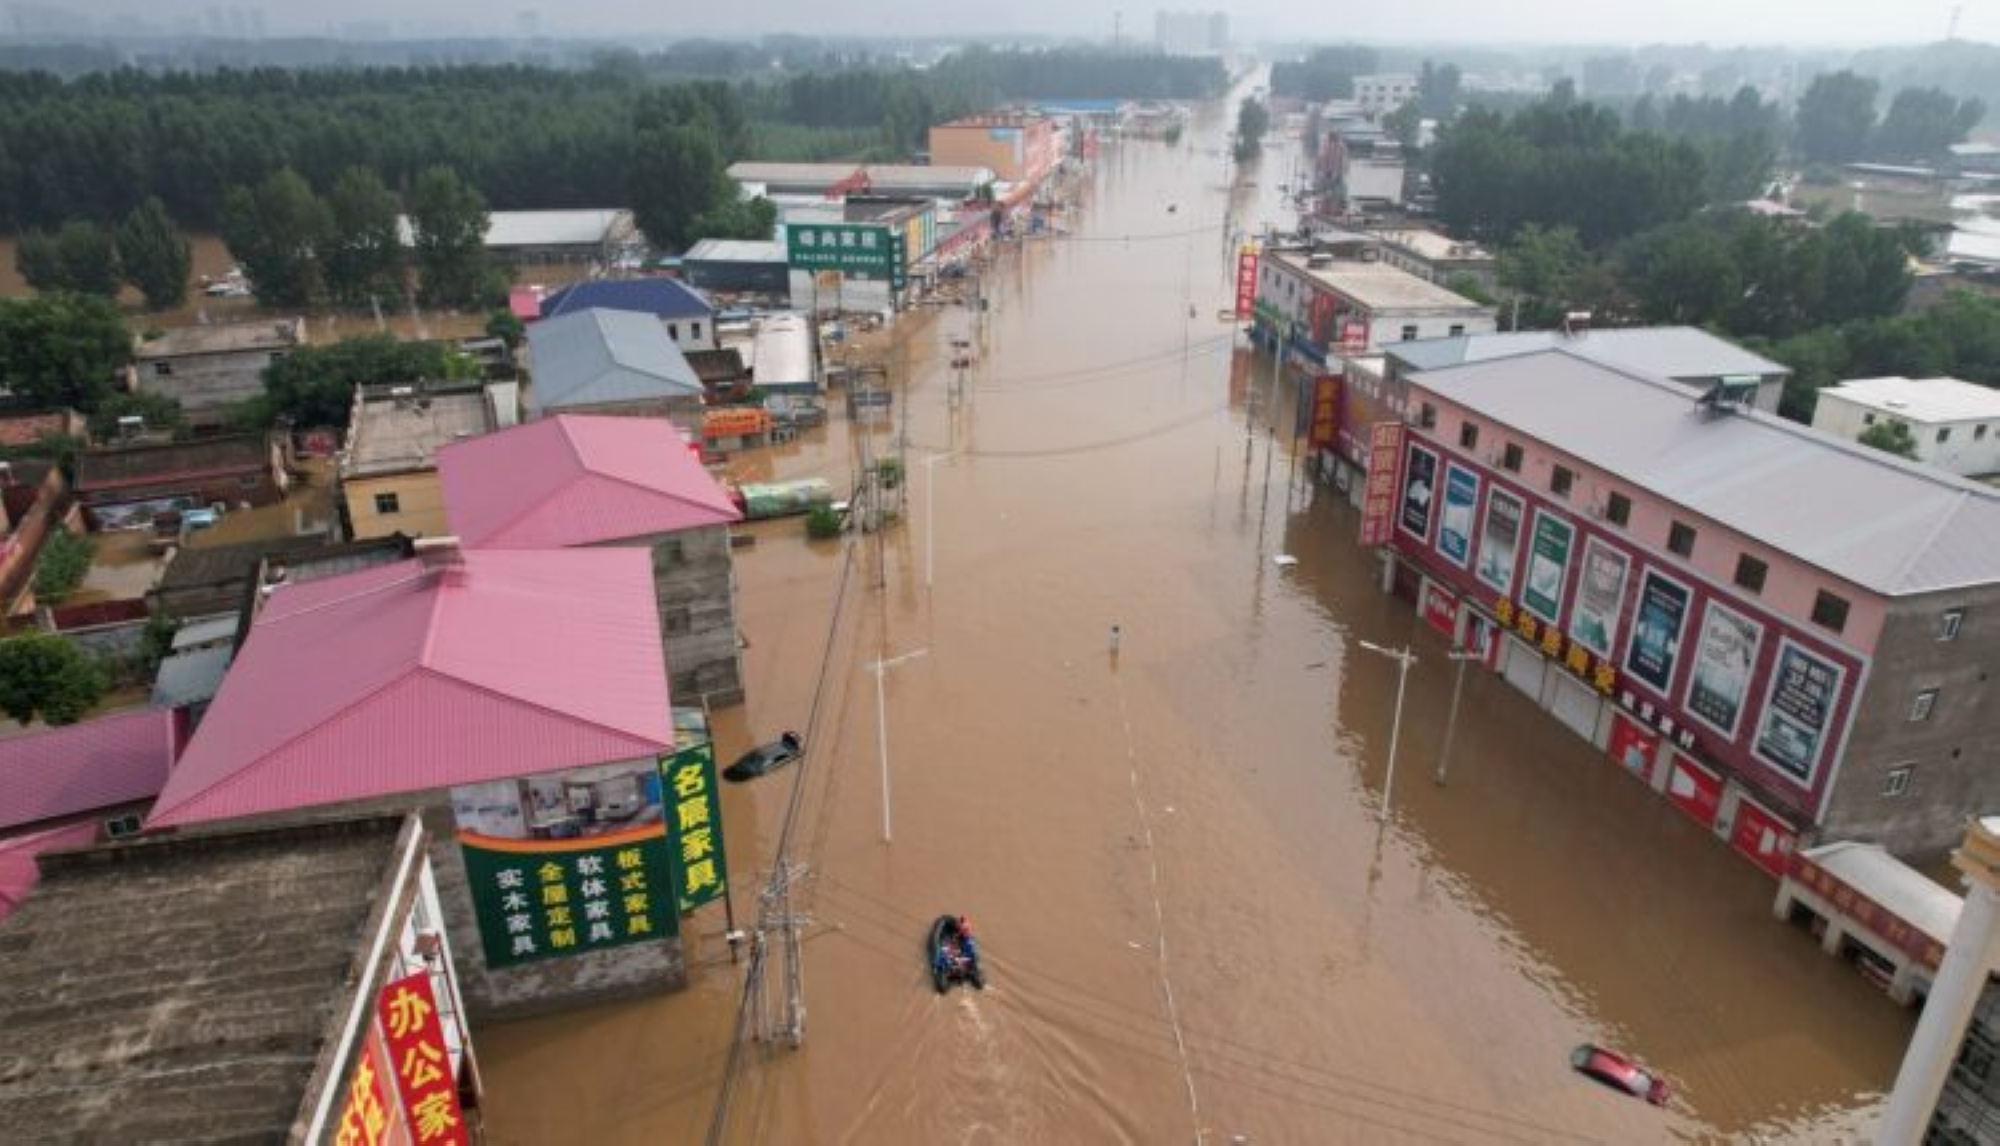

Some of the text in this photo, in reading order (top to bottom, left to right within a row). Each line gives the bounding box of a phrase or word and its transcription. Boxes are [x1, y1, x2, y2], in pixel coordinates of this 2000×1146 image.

[496, 869, 538, 956] 实木家具
[539, 862, 576, 948] 全屋定制
[577, 856, 614, 942] 软体家具
[617, 849, 651, 935] 板式家具
[389, 987, 458, 1146] 办公家
